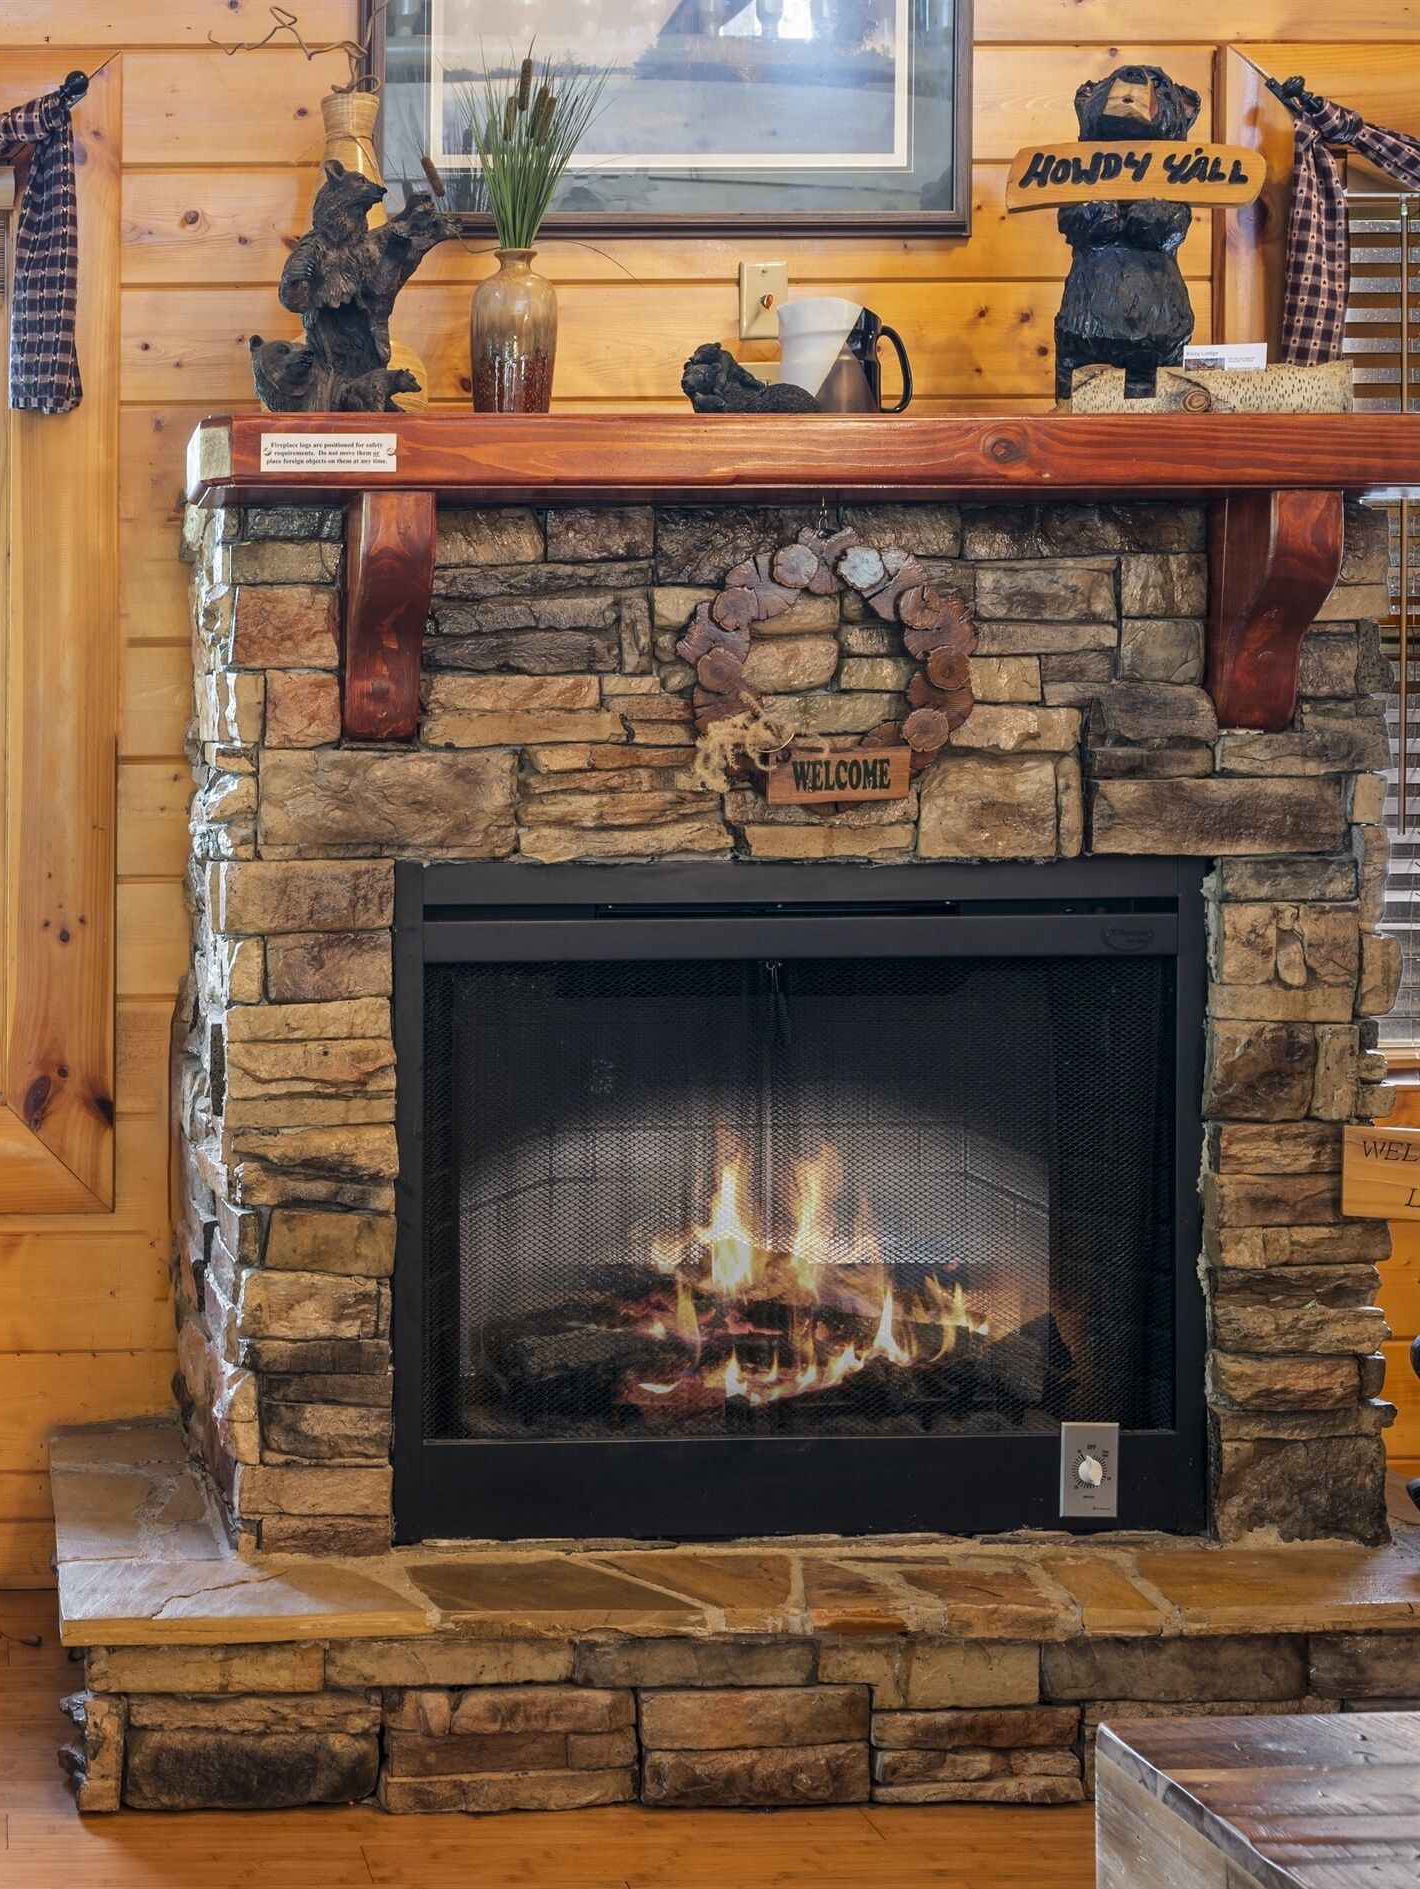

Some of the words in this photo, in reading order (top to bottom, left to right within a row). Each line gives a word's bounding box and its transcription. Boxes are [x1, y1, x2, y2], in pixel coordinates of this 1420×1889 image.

[1018, 151, 1152, 188] HOWDY
[1162, 147, 1249, 184] Y'ALL
[792, 758, 891, 792] WELCOME
